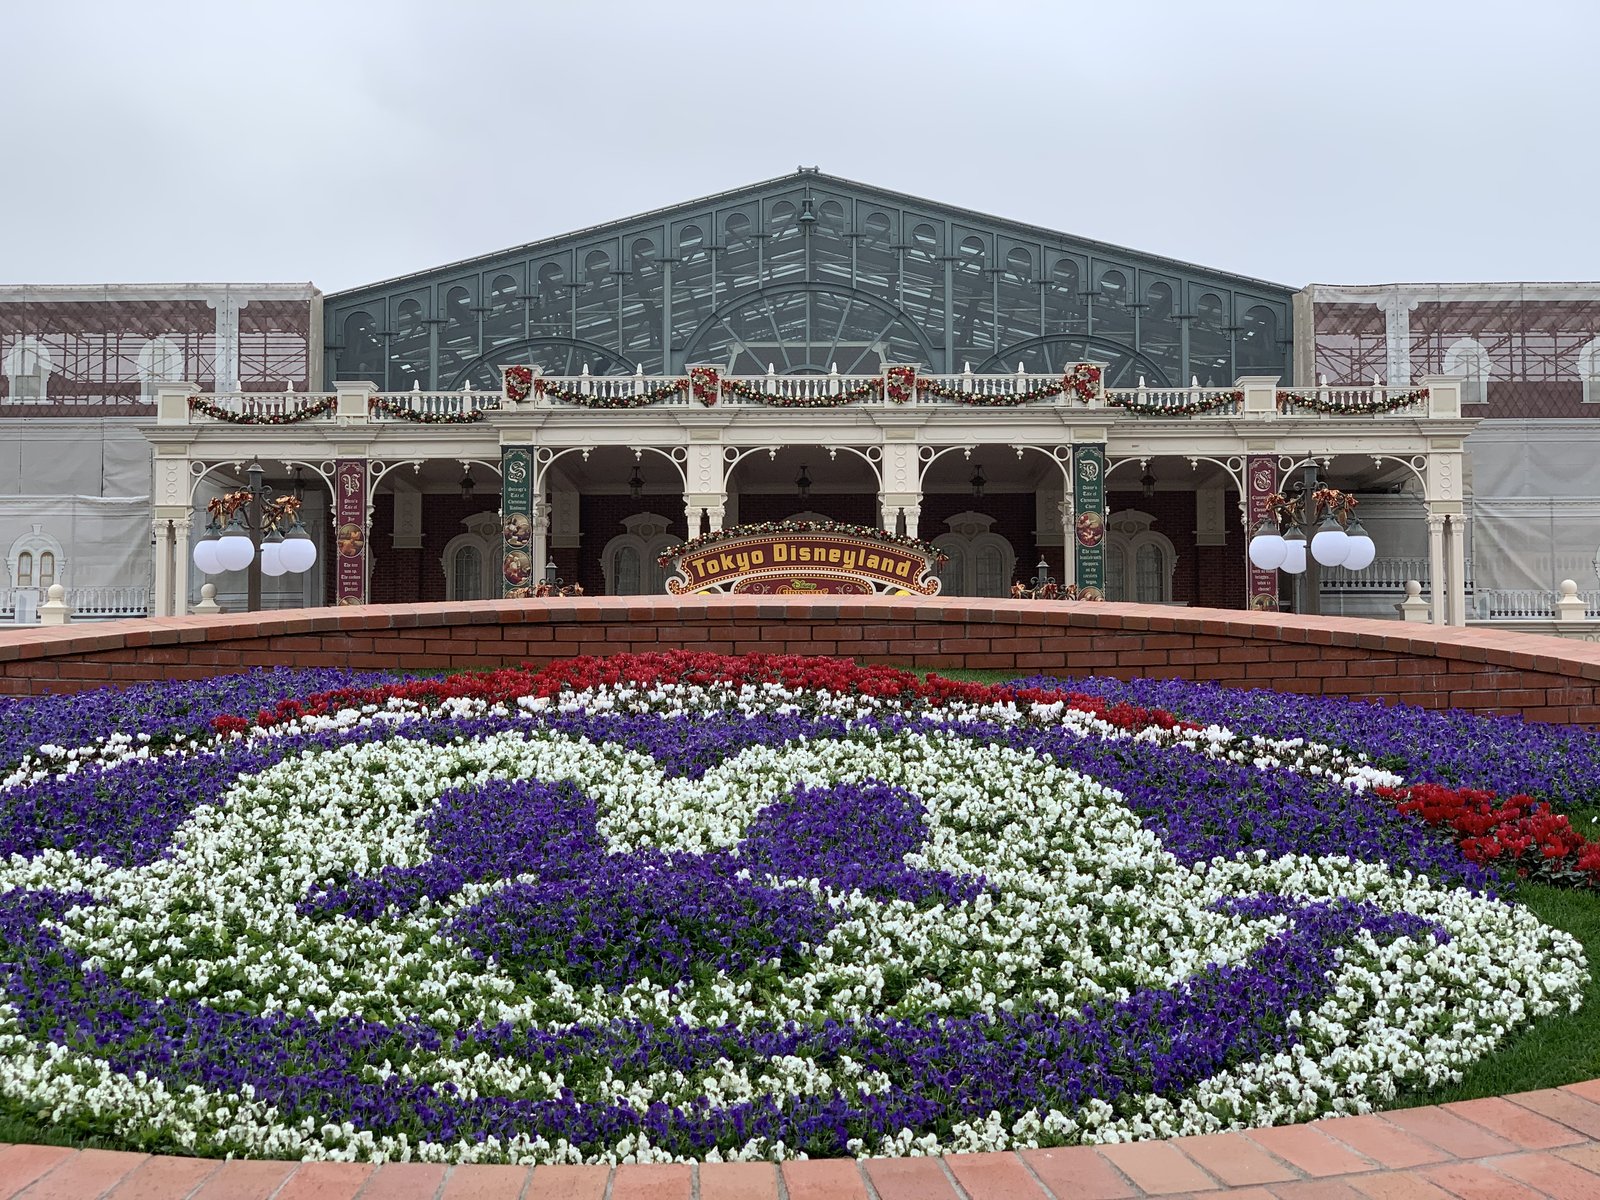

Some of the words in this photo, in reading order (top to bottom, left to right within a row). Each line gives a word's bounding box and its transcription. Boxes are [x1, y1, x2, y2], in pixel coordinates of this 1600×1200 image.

[692, 549, 764, 578] Tokyo
[773, 543, 912, 578] Disneyland
[791, 579, 817, 590] Disney
